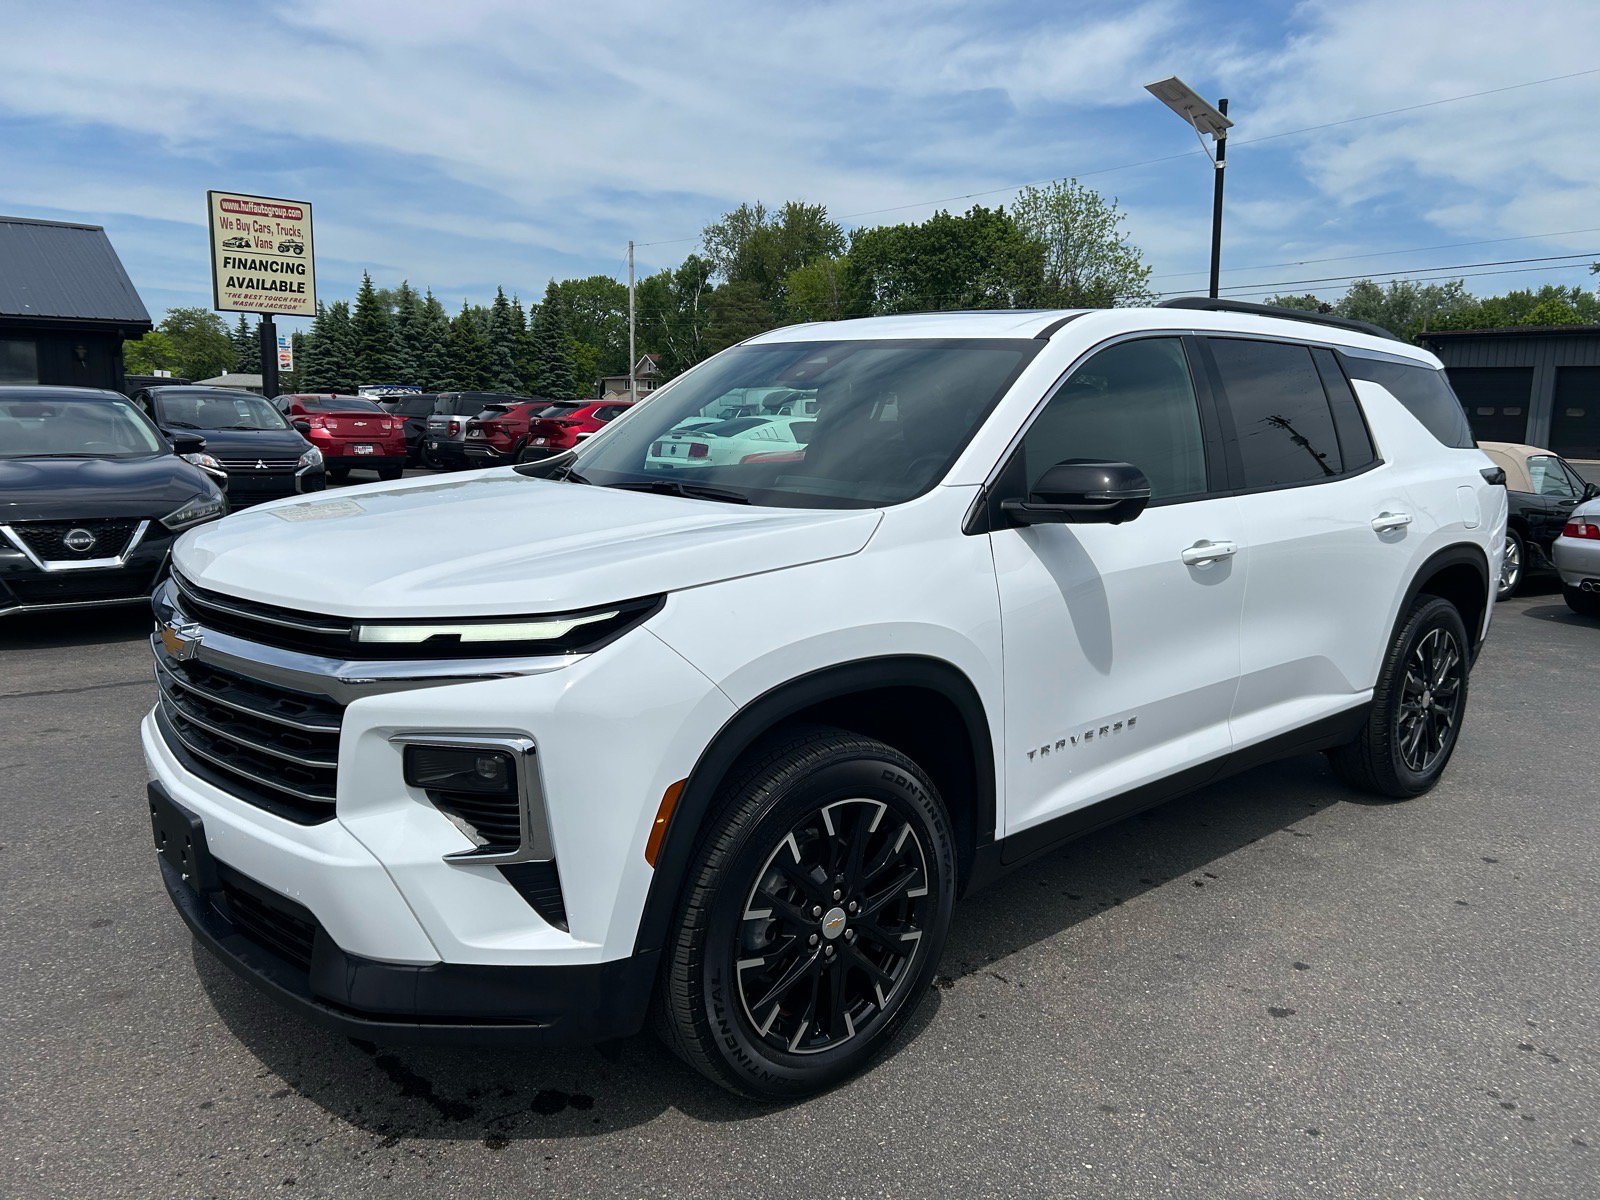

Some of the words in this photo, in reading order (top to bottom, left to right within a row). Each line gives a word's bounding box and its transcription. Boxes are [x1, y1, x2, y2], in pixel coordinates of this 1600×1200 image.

[221, 200, 302, 219] www.huffautogroup.com
[219, 216, 234, 230] We
[236, 219, 250, 235] Buy
[252, 220, 274, 236] Cars,
[275, 222, 304, 240] Trucks,
[253, 235, 273, 249] Vans
[223, 256, 306, 276] FINANCING
[226, 276, 305, 293] AVAILABLE
[264, 295, 288, 303] TOUCH
[1027, 716, 1137, 760] TRAVERSE
[881, 769, 954, 893] CONTINENTAL
